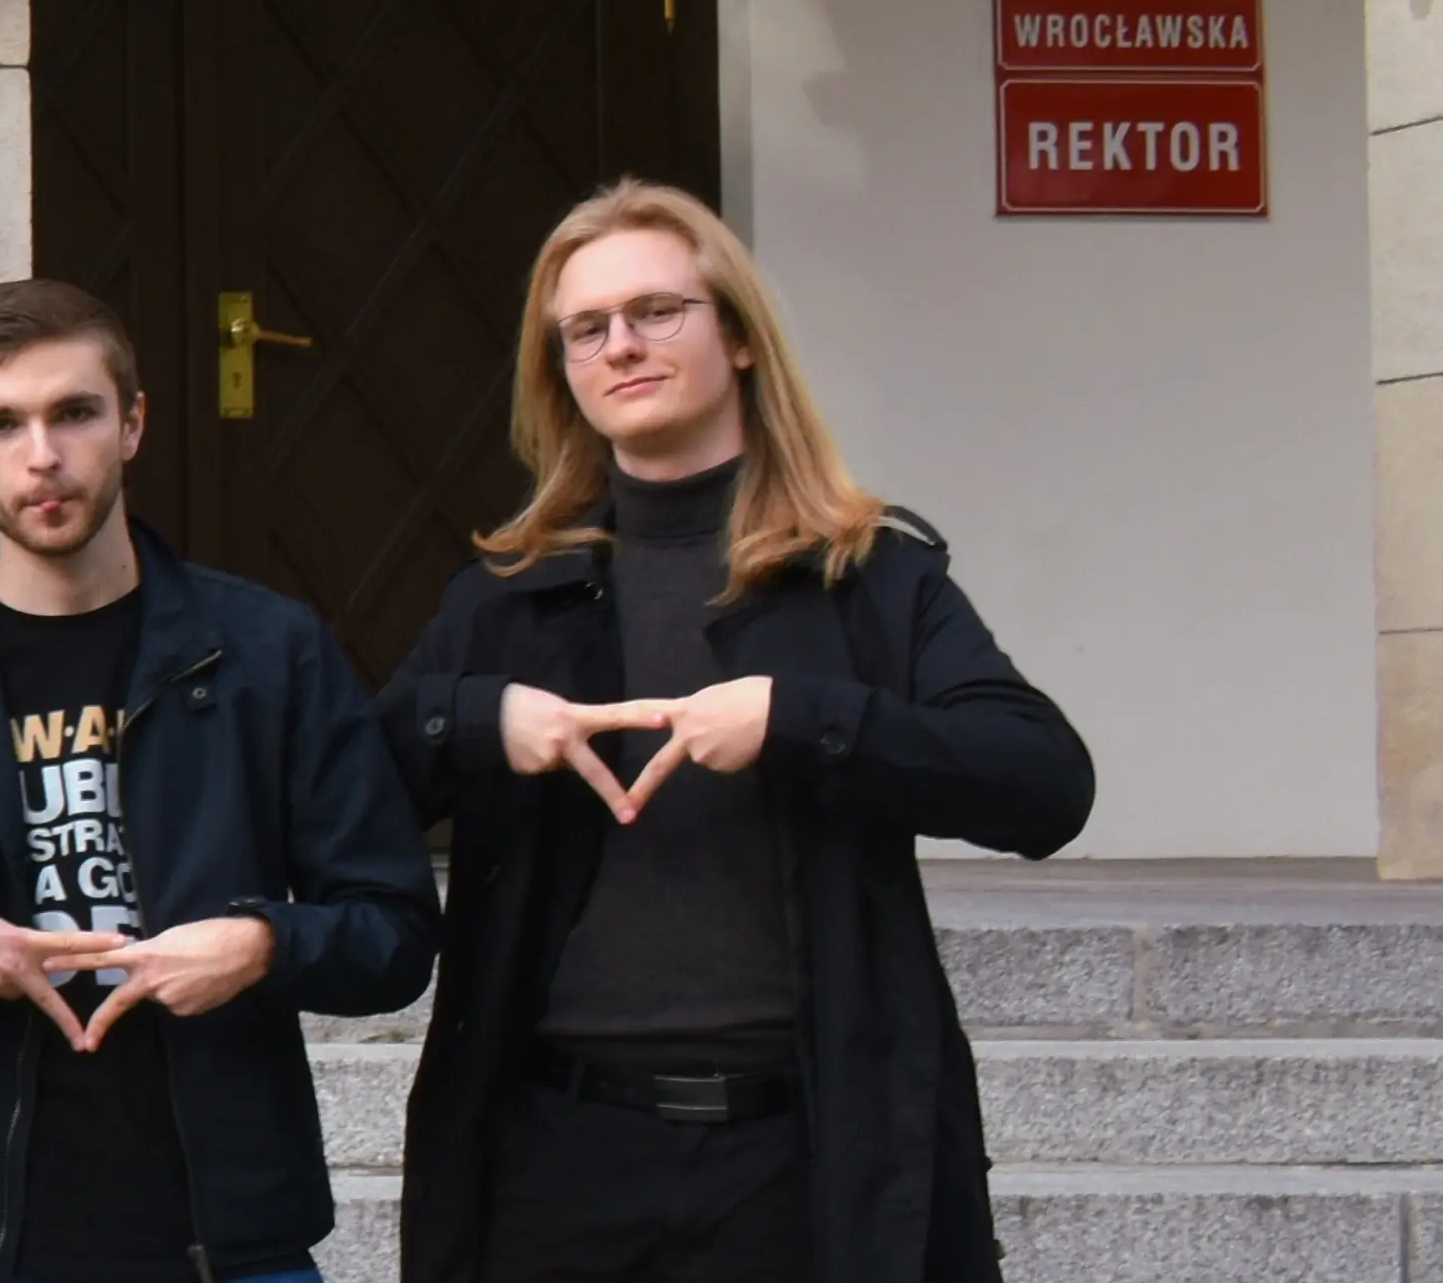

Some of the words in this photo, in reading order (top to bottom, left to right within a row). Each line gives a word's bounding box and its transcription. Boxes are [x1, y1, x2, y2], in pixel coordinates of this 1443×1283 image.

[1014, 13, 1249, 49] WROCŁAWSKA
[1027, 121, 1240, 171] REKTOR
[27, 818, 125, 863] STRA
[34, 864, 68, 905] A
